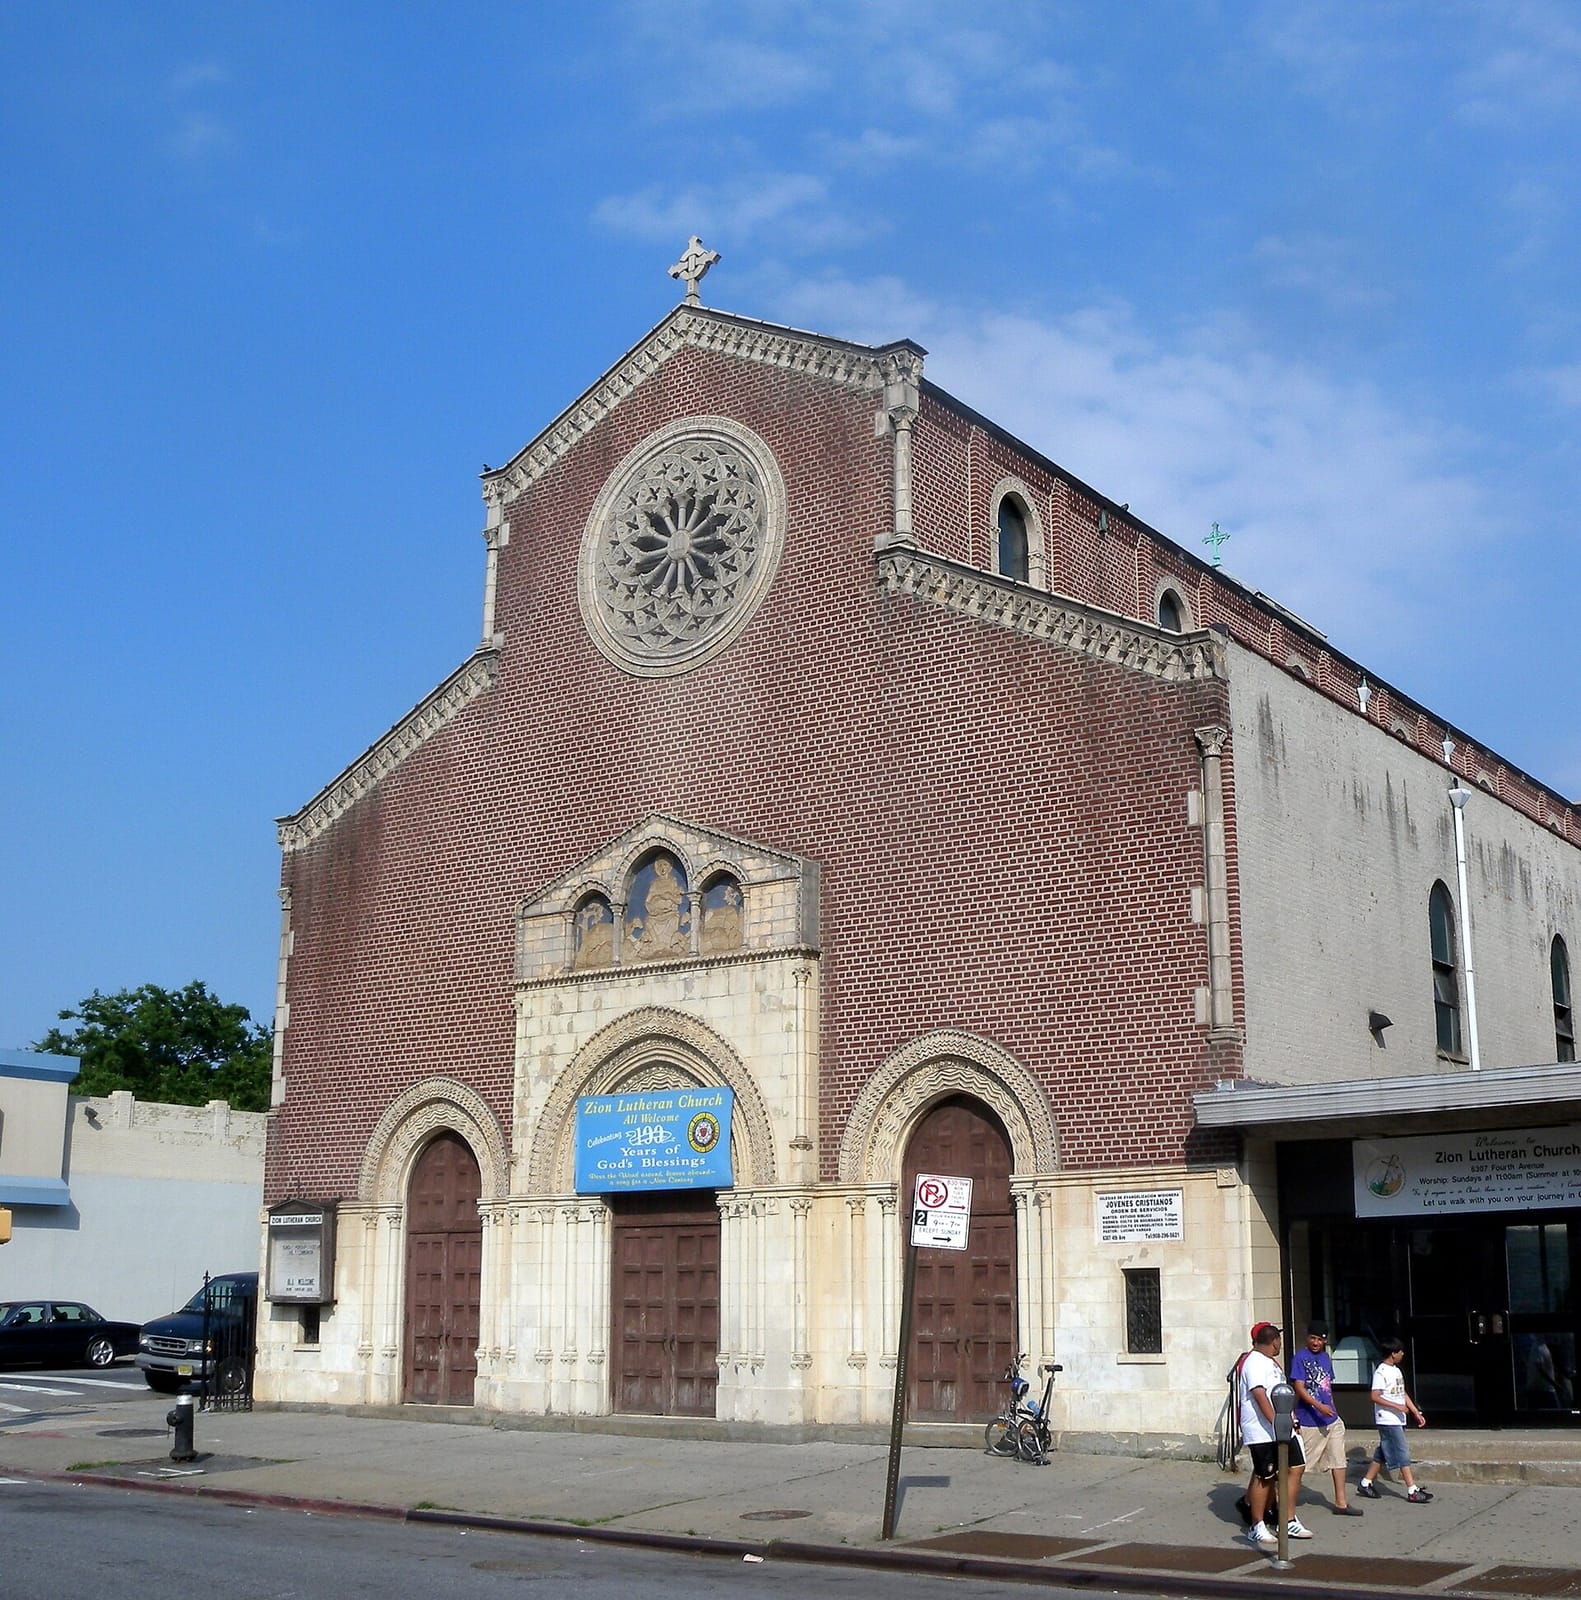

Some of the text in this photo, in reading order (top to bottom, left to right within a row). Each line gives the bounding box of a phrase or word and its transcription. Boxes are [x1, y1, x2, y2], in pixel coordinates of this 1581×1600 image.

[584, 1094, 722, 1114] Zion Lutheran Church
[624, 1113, 679, 1124] All Welcome
[587, 1132, 622, 1148] Celebrating
[634, 1125, 667, 1145] 100
[620, 1144, 680, 1156] Years of
[1436, 1144, 1580, 1163] Zion Lutheran Church
[597, 1157, 706, 1169] God's Blessings
[1491, 1162, 1515, 1171] Fourth
[1106, 1198, 1173, 1208] JOVENES CRISTIANOS
[1538, 1193, 1564, 1202] journey
[917, 1211, 925, 1225] 2
